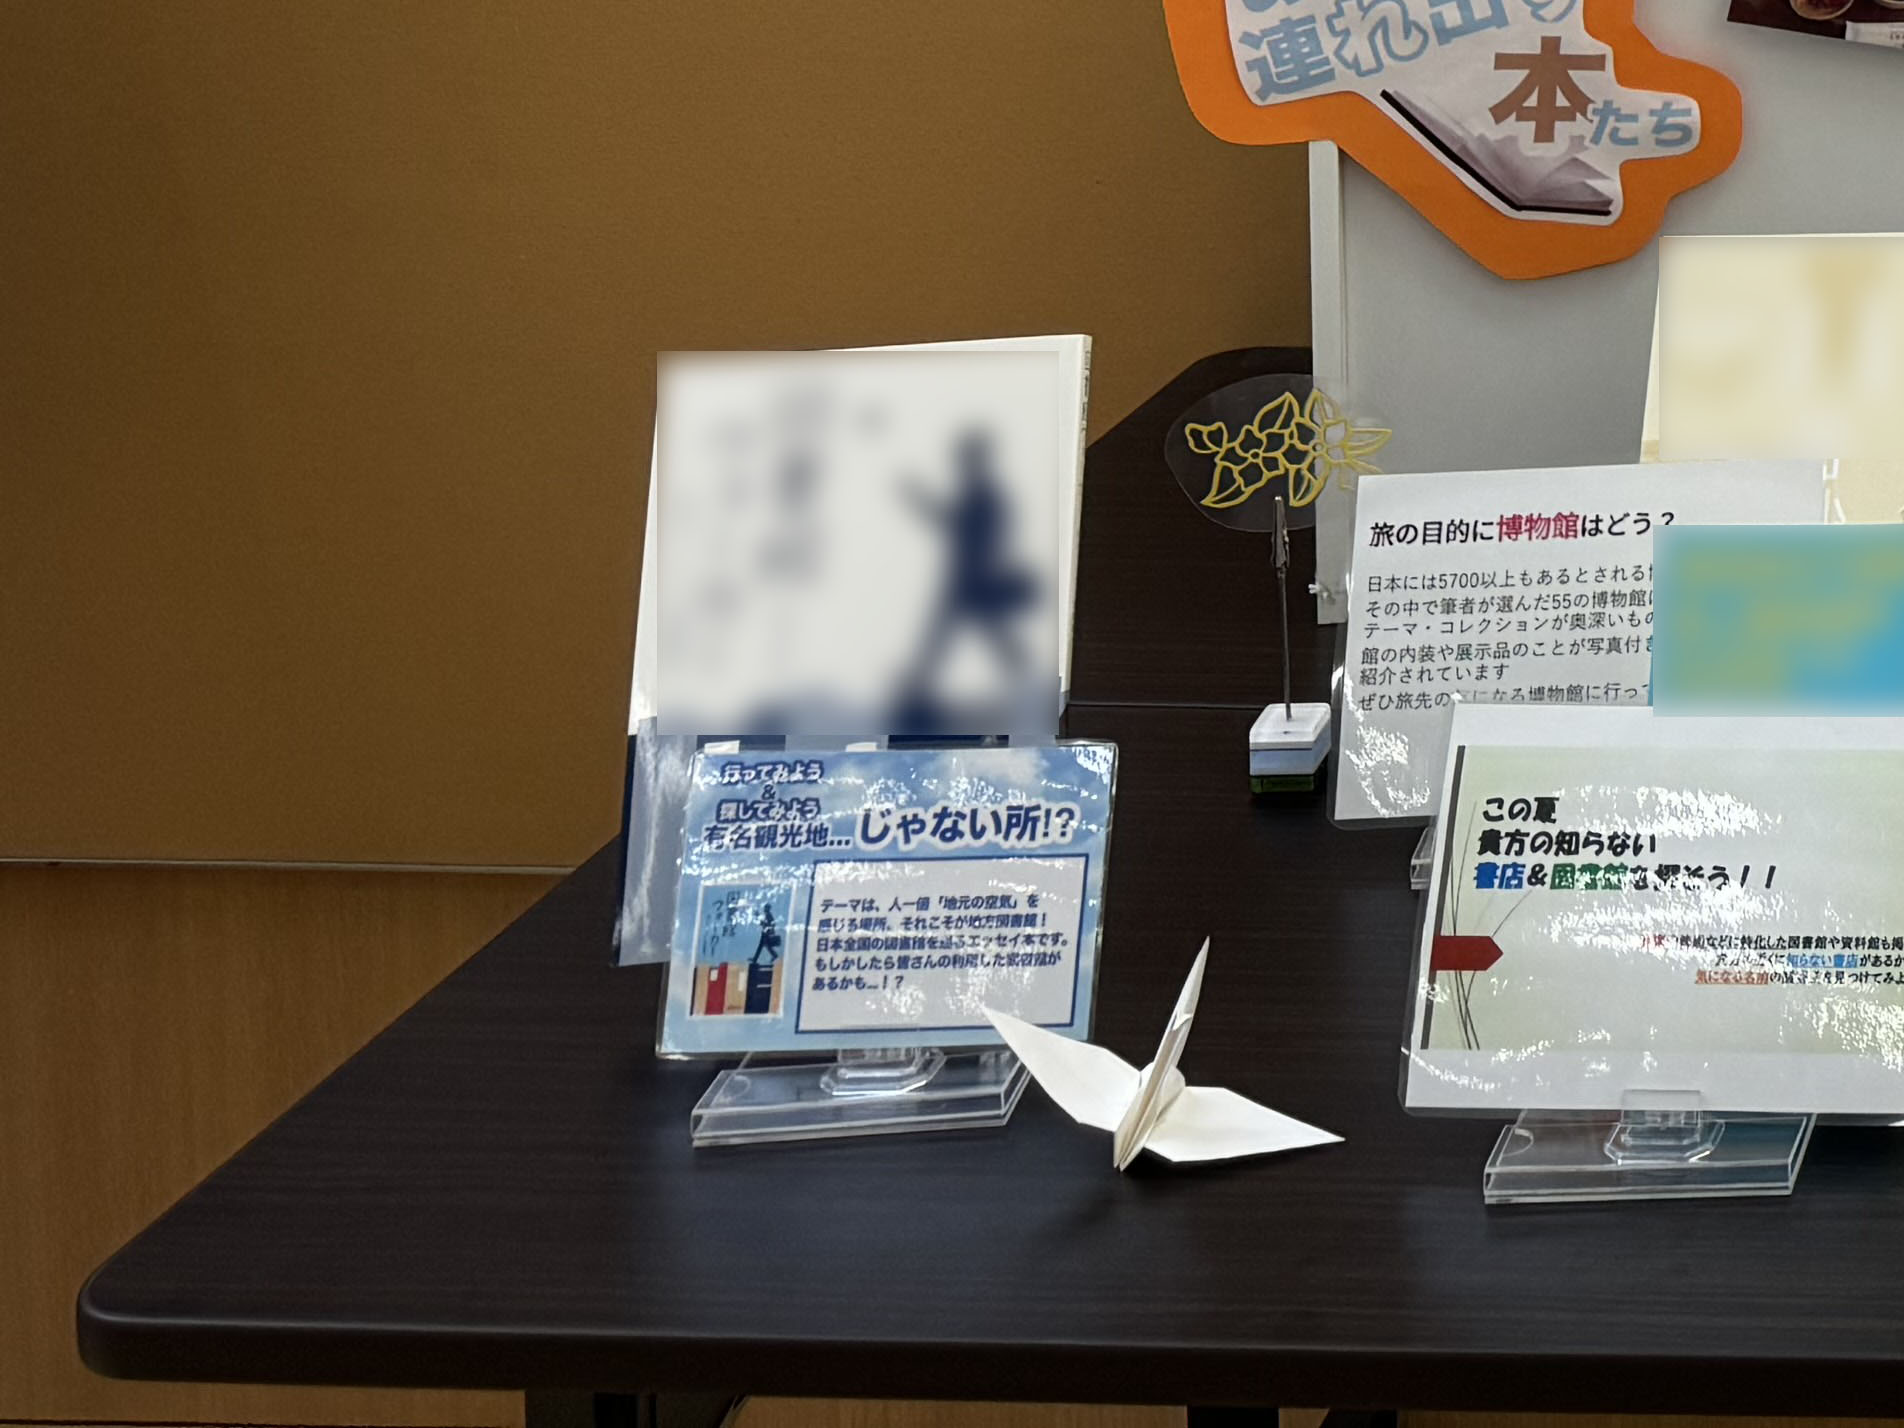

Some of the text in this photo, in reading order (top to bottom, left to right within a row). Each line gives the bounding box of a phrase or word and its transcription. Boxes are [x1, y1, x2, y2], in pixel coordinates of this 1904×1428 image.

[1488, 35, 1693, 146] 本たち
[1359, 662, 1506, 687] 紹介されています
[1482, 796, 1560, 824] この夏
[1477, 830, 1656, 856] 貴方の知らない
